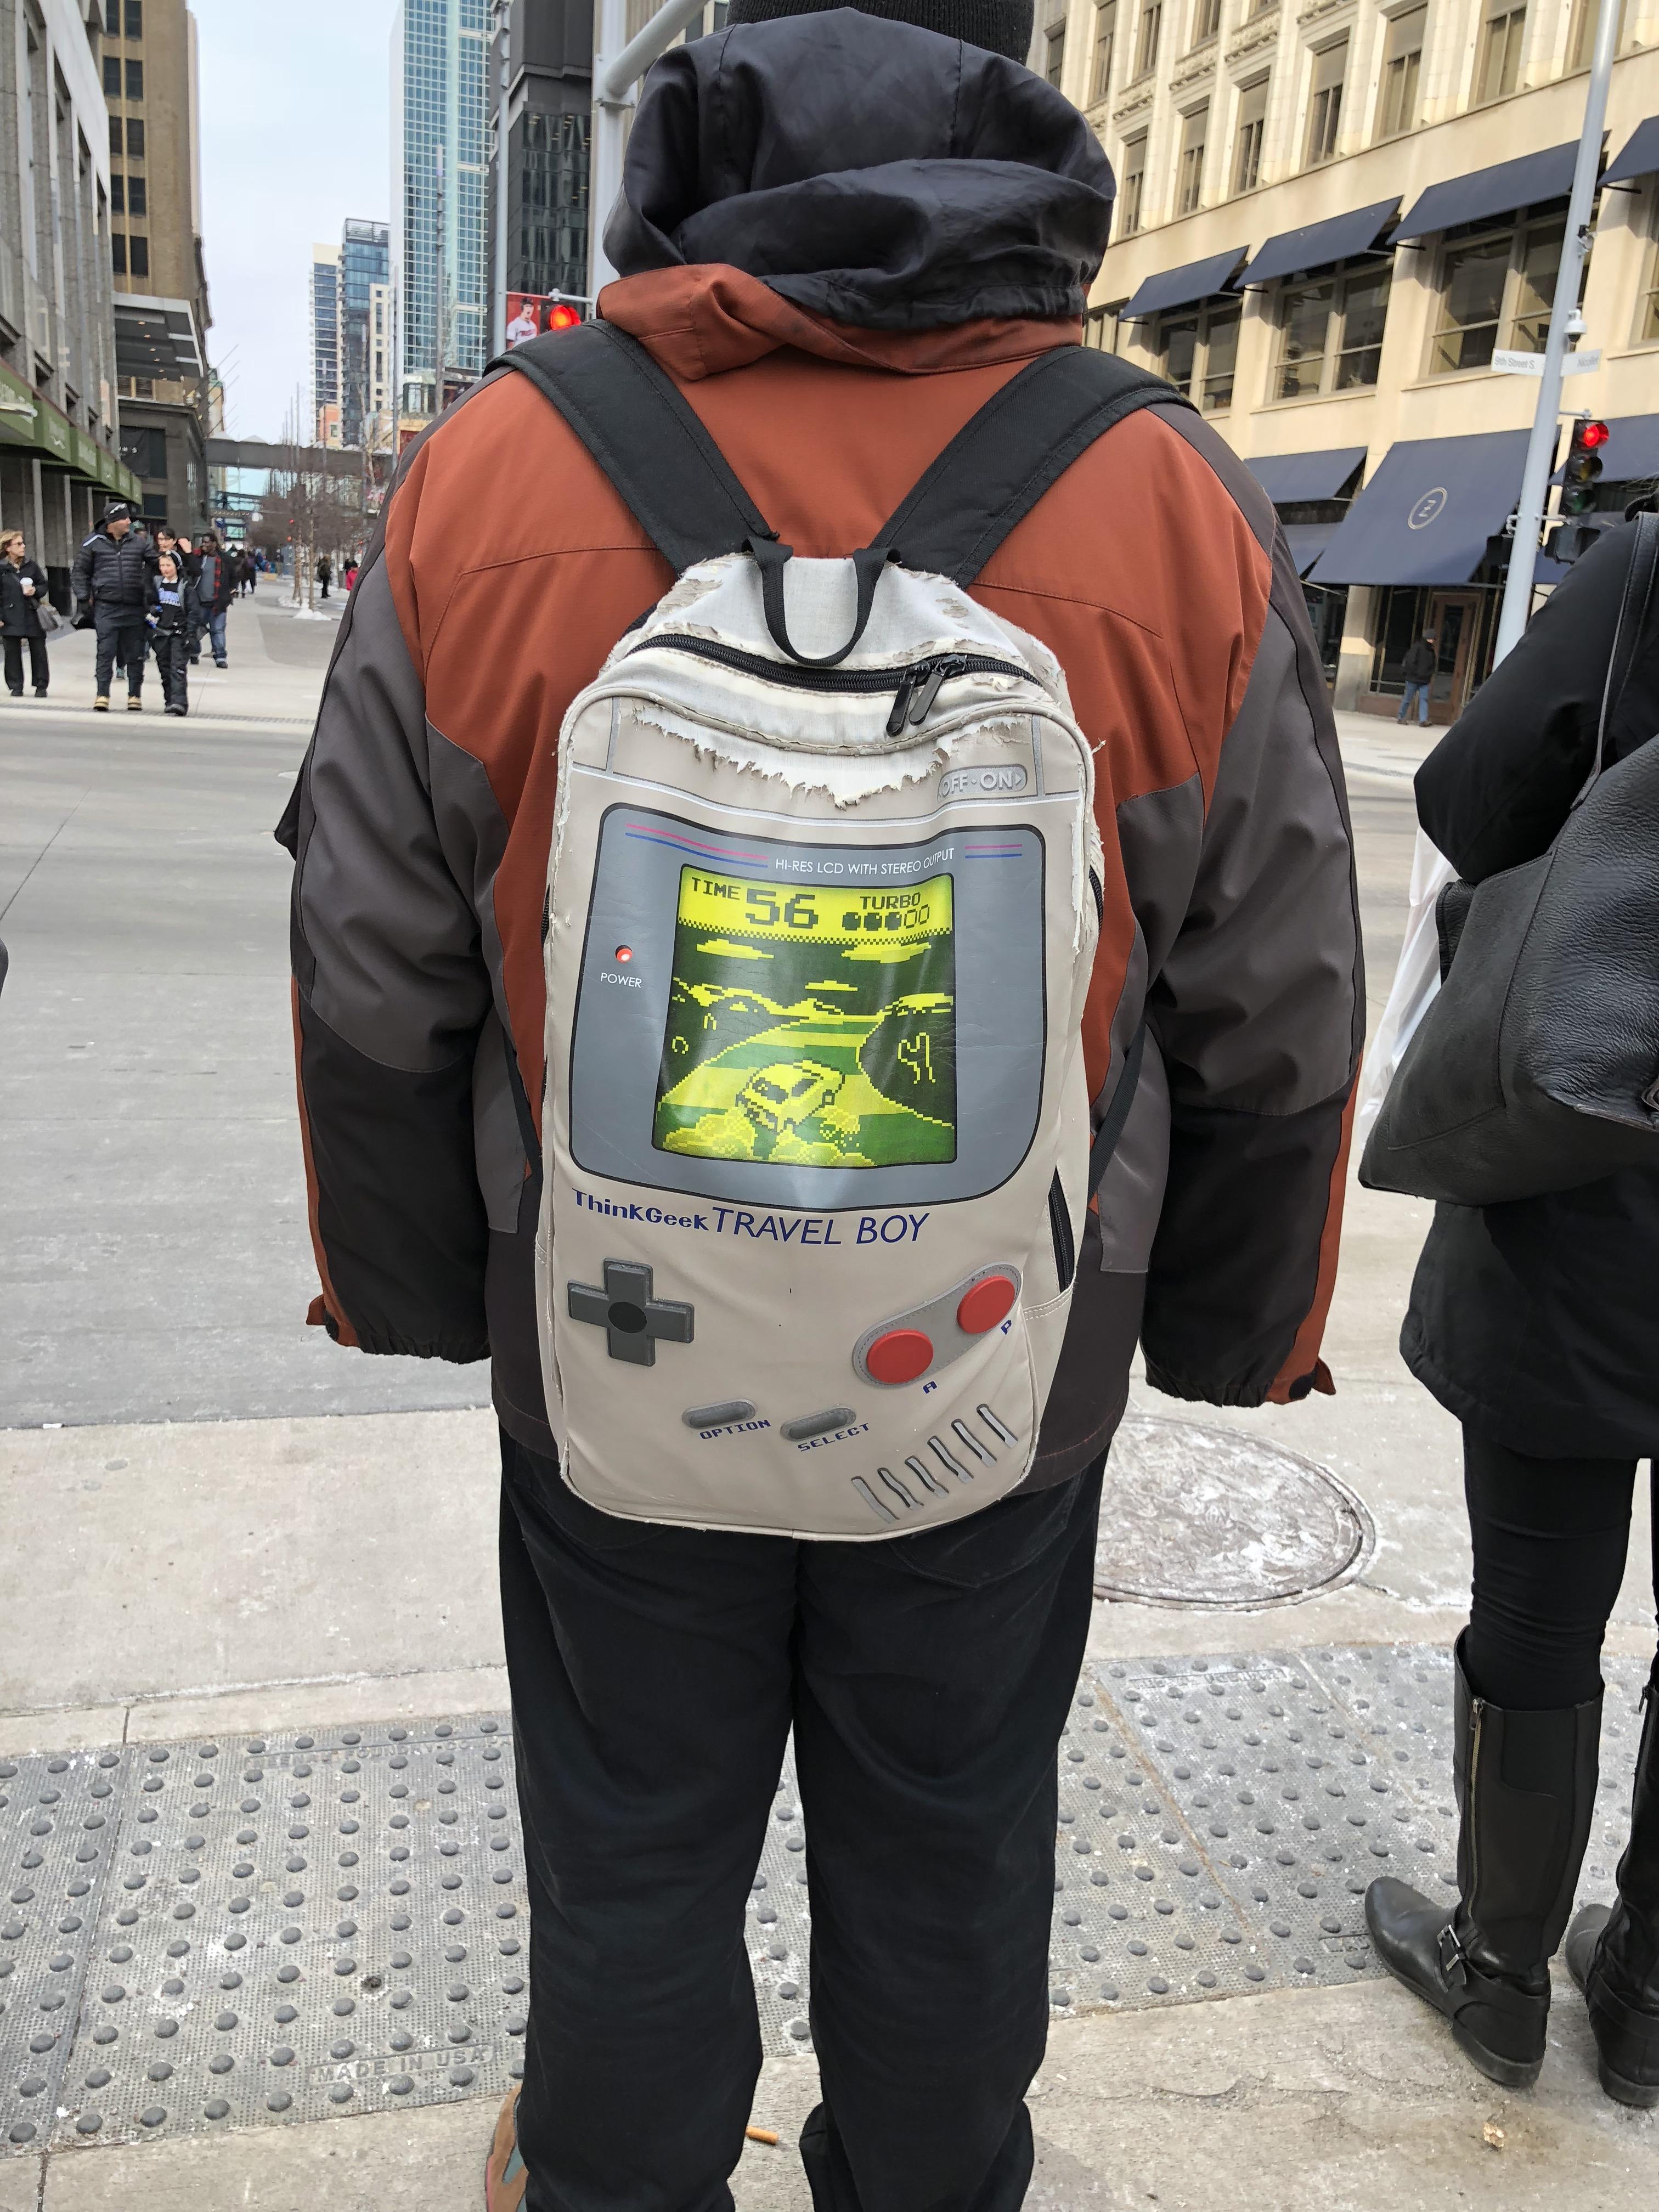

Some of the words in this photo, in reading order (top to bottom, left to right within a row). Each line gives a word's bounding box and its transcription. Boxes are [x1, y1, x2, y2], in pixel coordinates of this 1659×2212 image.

[941, 774, 968, 798] OFF
[980, 771, 1013, 791] ON
[775, 858, 813, 873] HI-RES
[817, 861, 844, 874] LCD
[848, 863, 877, 875] WITH
[881, 859, 921, 875] STEREO
[923, 848, 955, 869] OUTPUT
[692, 877, 741, 900] TIME
[860, 891, 921, 910] TURBO
[745, 888, 819, 929] 56
[600, 972, 642, 988] POWER
[712, 1206, 842, 1245] TRAVEL
[856, 1212, 930, 1245] BOY
[699, 1419, 772, 1440] OPTION
[797, 1423, 870, 1452] SELECT
[317, 2061, 385, 2083] MADE
[400, 2056, 423, 2073] IN
[437, 2048, 484, 2067] USA
